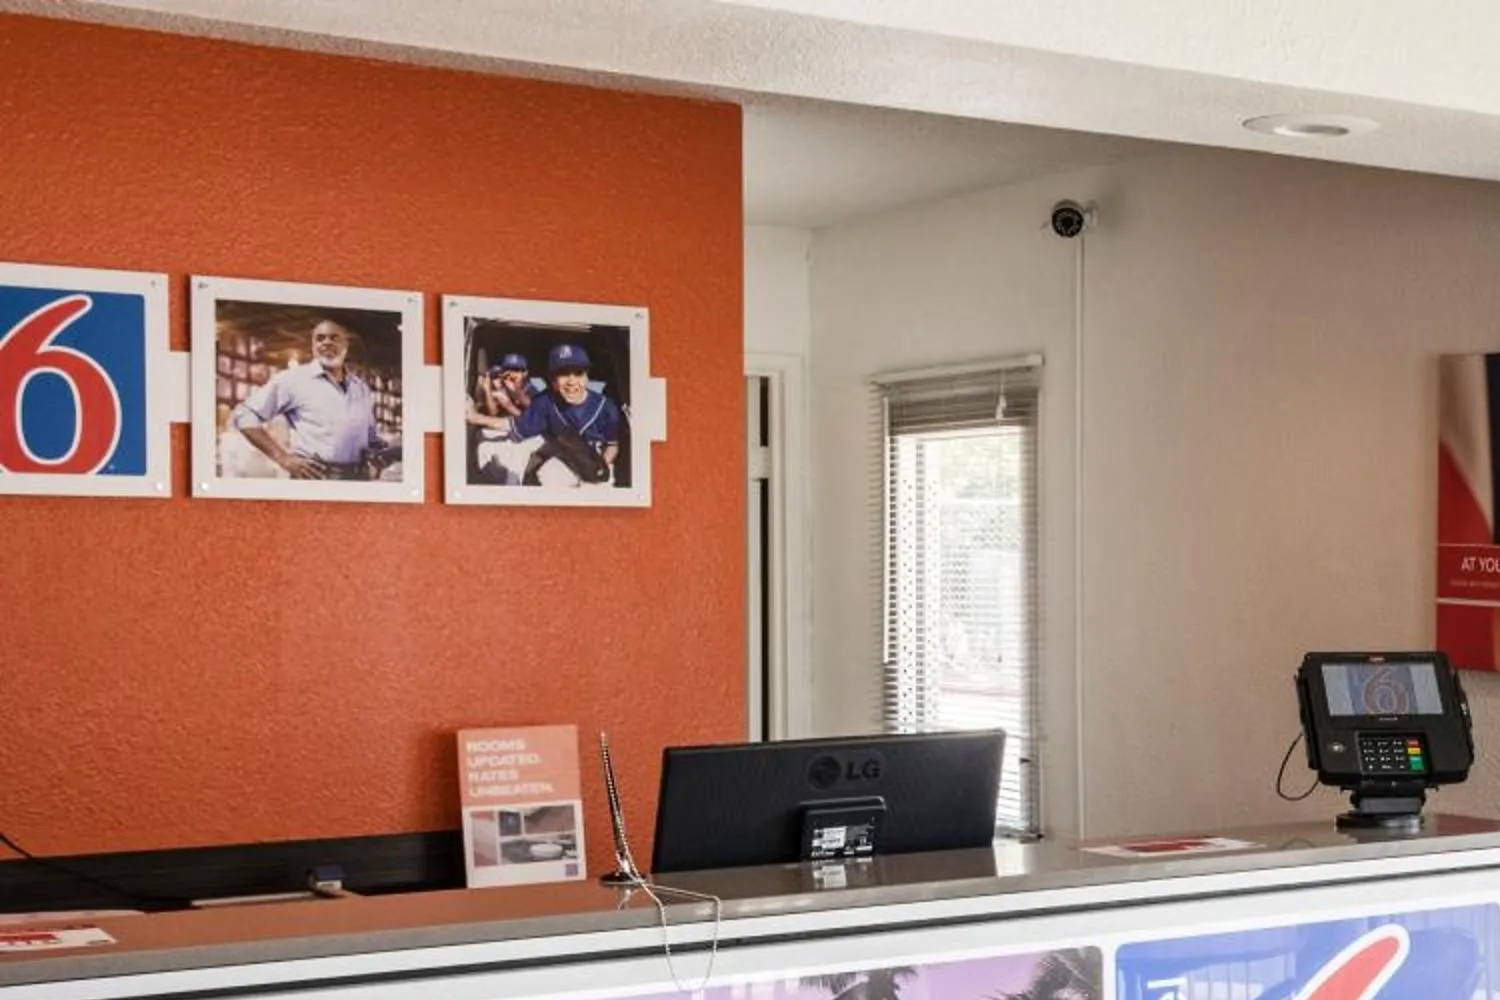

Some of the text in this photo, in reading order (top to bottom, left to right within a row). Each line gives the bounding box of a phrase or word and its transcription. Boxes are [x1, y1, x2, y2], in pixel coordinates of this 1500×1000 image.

[0, 294, 122, 475] 6
[1461, 557, 1476, 572] AT
[465, 739, 526, 753] ROOMS
[468, 769, 520, 782] RATES
[846, 758, 881, 781] LG
